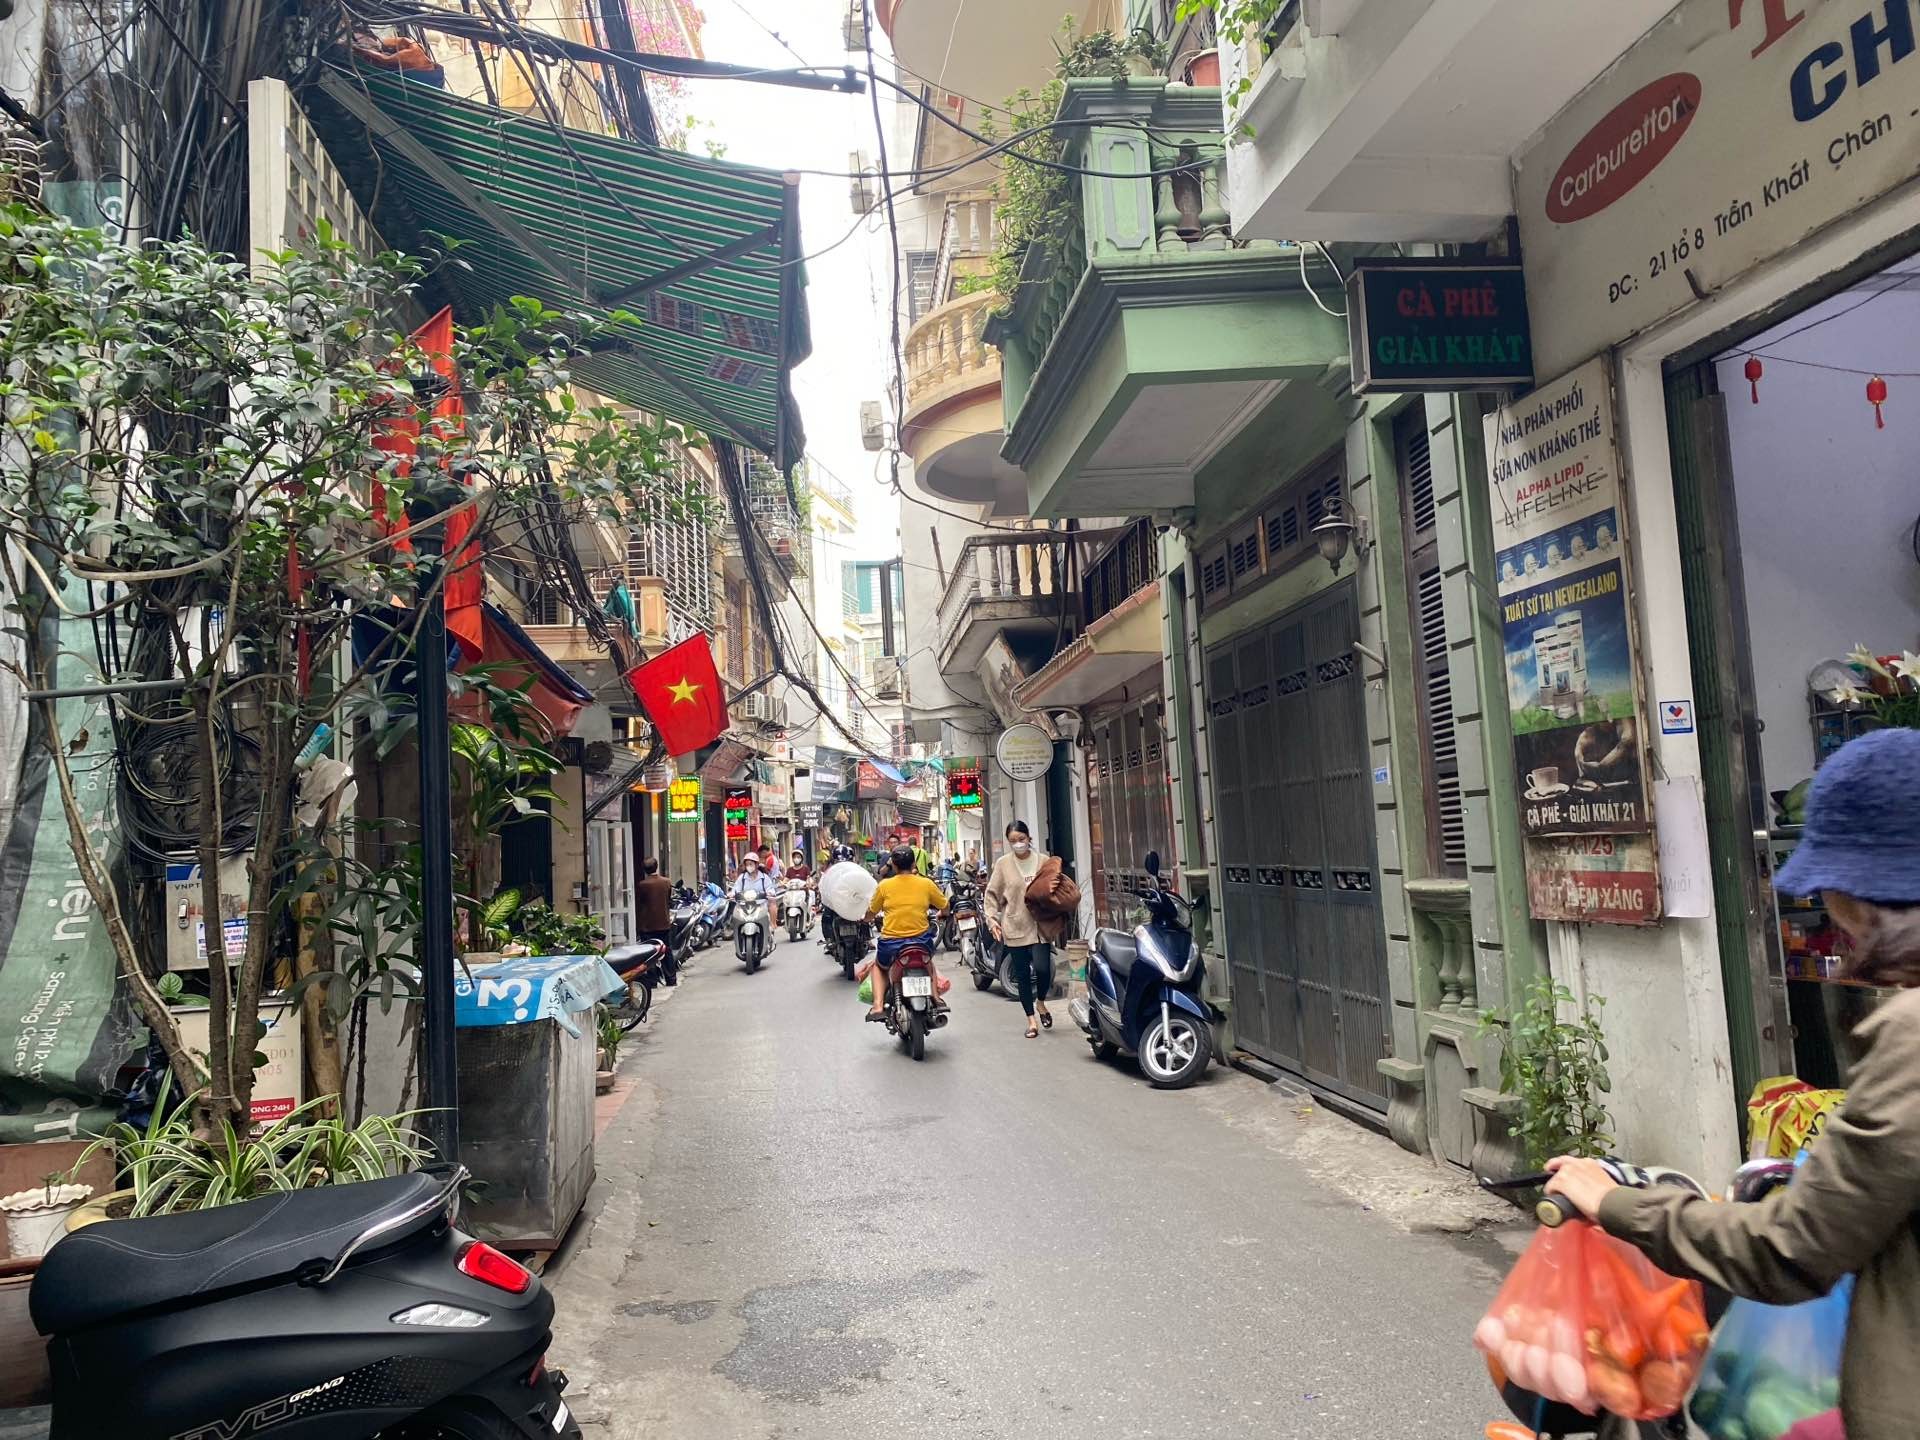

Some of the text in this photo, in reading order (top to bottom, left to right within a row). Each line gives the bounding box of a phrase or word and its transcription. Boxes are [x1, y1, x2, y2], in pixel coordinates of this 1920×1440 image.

[1789, 0, 1920, 122] CH
[1560, 94, 1683, 207] Carburettor
[1609, 274, 1639, 304] ĐC:
[1671, 227, 1691, 265] tổ
[1693, 228, 1706, 250] 8
[1714, 200, 1753, 236] Trần
[1763, 159, 1811, 207] Khát
[1827, 112, 1893, 167] Chân
[1397, 279, 1499, 318] CÀ PHÊ
[1376, 325, 1525, 365] GIẢI KHÁT
[1501, 380, 1584, 448] NHÀ PHÂN PHỐI
[1492, 405, 1602, 486] SỮA NON KHÁNG THỂ
[1504, 471, 1600, 527] LIFELINE
[1516, 461, 1585, 504] ALPHA LIPID
[1504, 570, 1618, 624] XUẤT SỨ TẠI NEWZEALAND
[803, 819, 819, 828] 50K
[1526, 798, 1636, 827] CÀ PHÊ GIẢI KHÁT 21
[174, 882, 201, 890] VNPT
[1600, 880, 1644, 911] XĂNG
[20, 971, 66, 1024] Samsung
[250, 1104, 290, 1114] ONG 24H
[289, 1375, 345, 1404] GRAND
